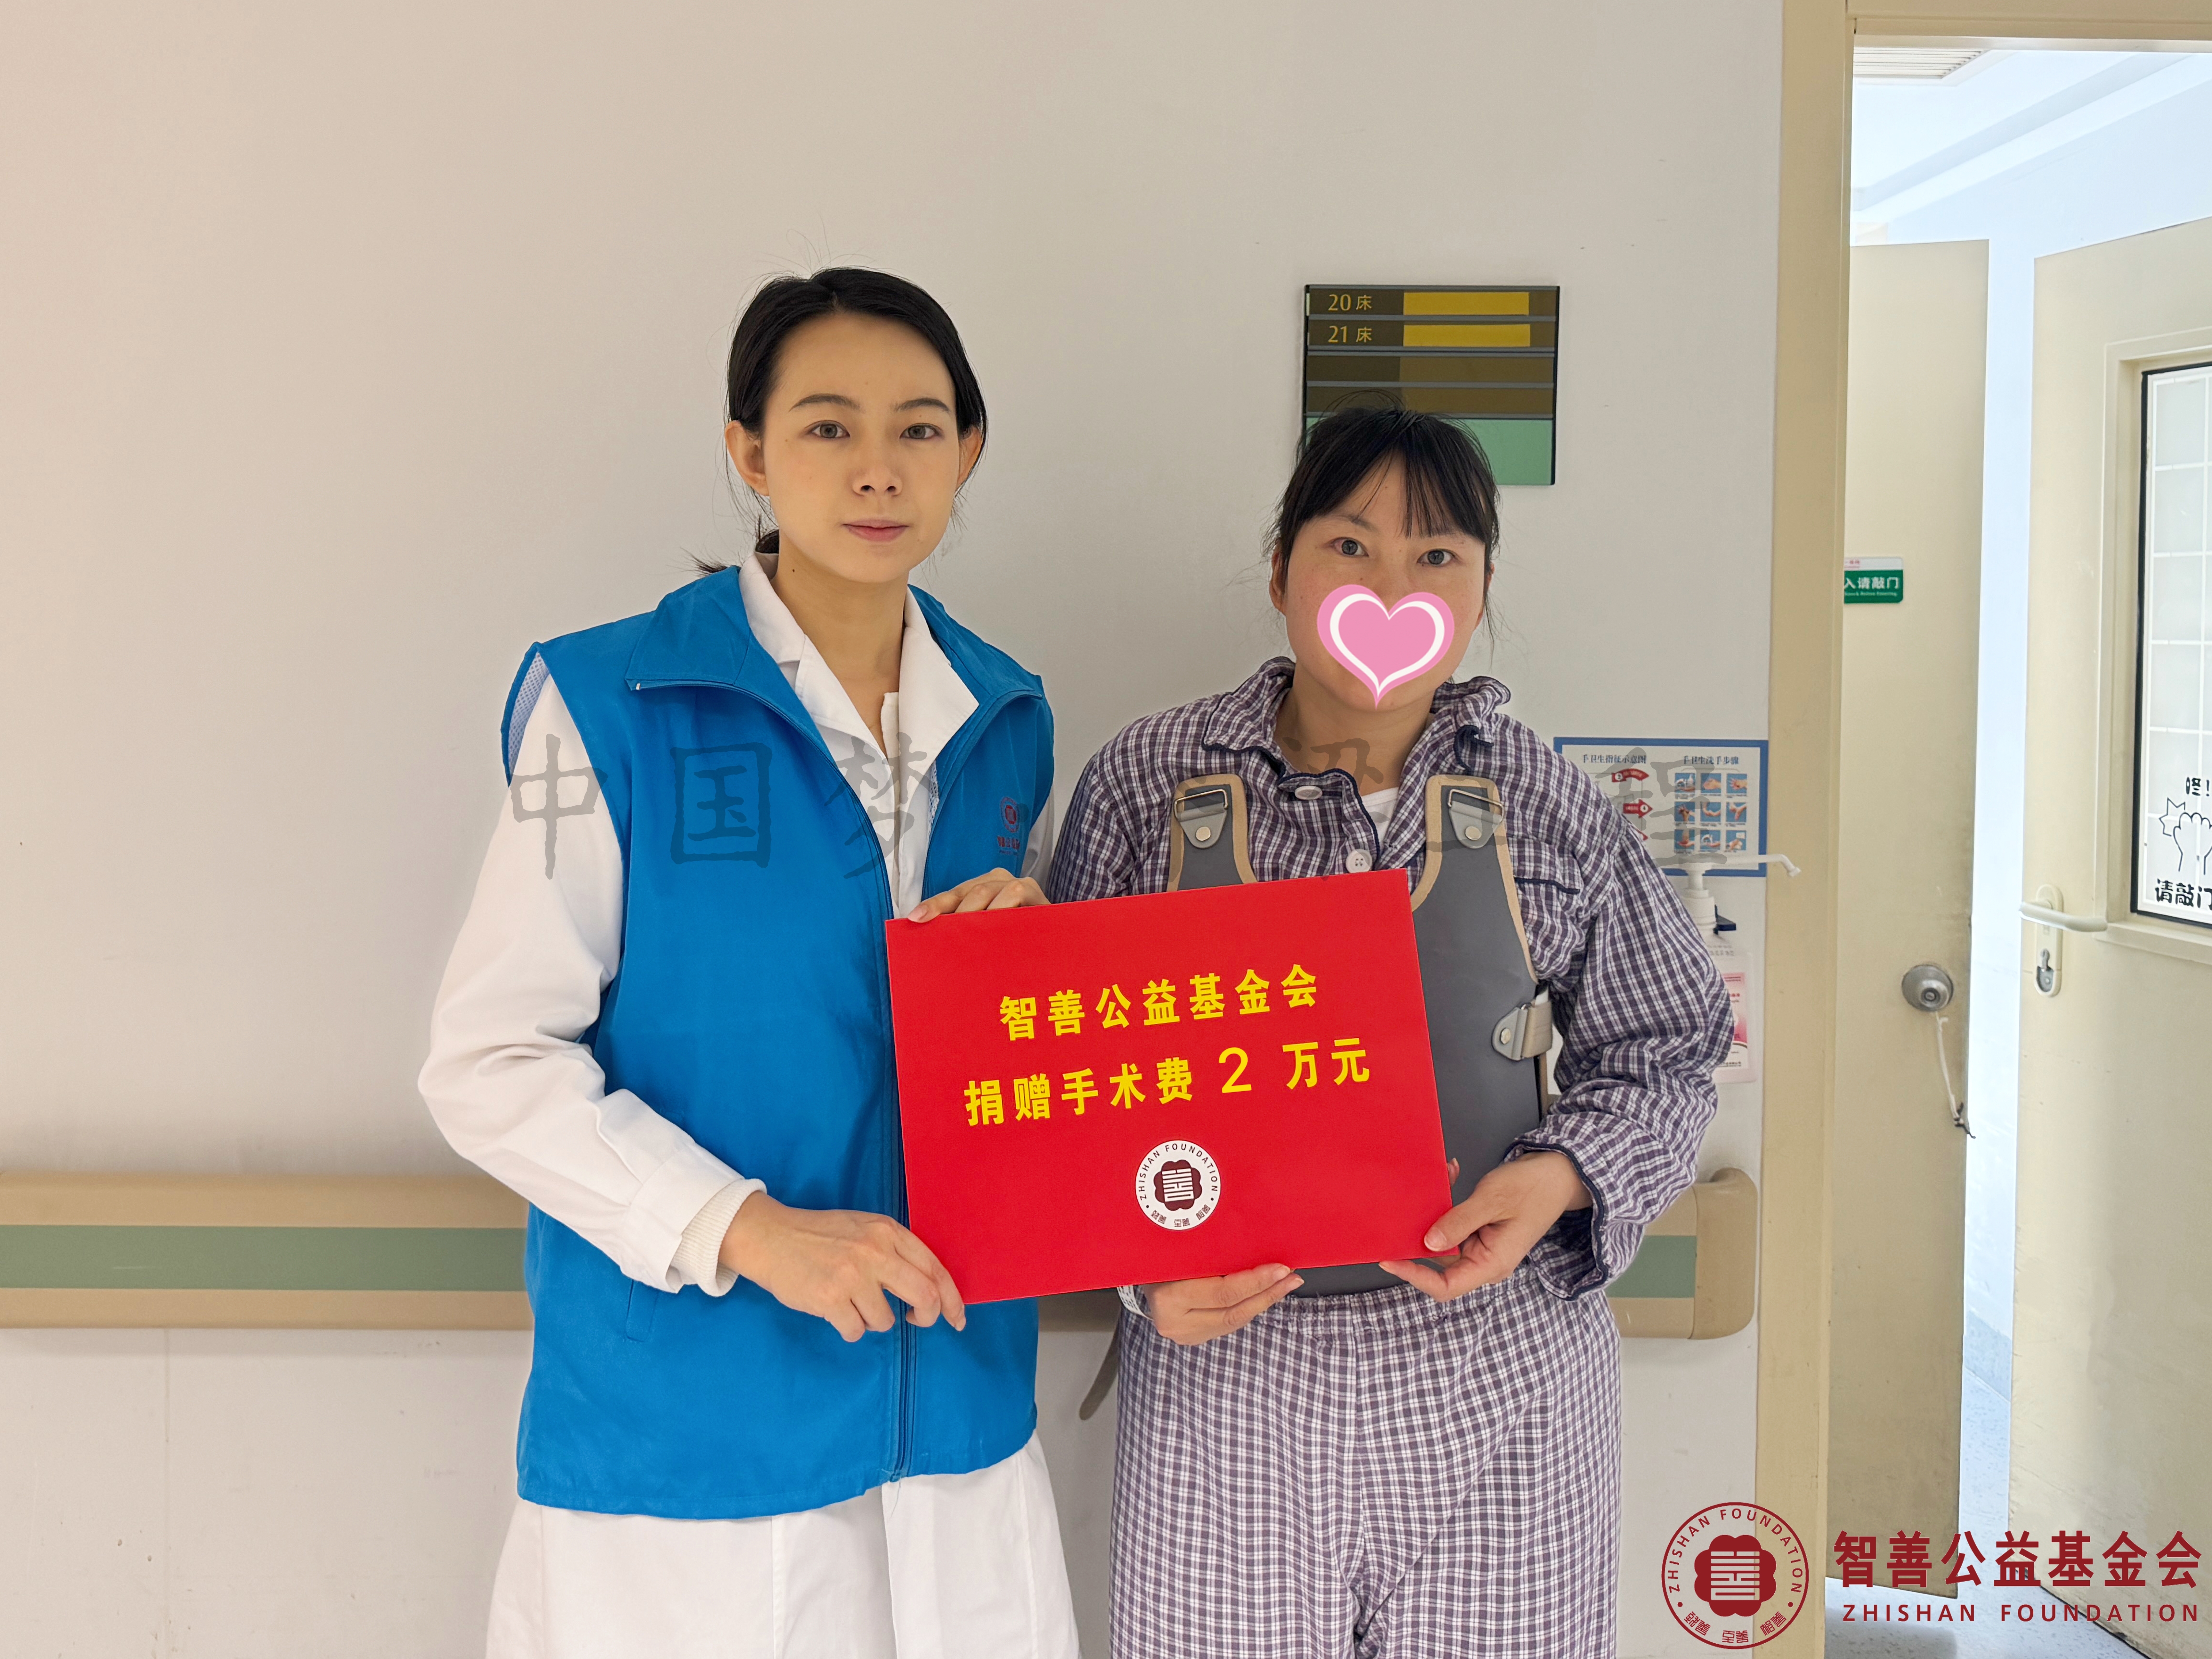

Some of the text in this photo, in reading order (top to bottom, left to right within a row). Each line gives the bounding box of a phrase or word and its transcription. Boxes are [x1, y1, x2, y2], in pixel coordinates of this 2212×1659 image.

[1328, 294, 1372, 311] 20 床
[1328, 326, 1372, 343] 21 床
[2155, 878, 2212, 910] 请敲门
[1000, 964, 1316, 1041] 智善公益基金会
[964, 1038, 1370, 1126] 捐赠手术费 2 万元
[1139, 1151, 1160, 1200] ZHISHAN
[1165, 1143, 1218, 1191] FOUNDATION
